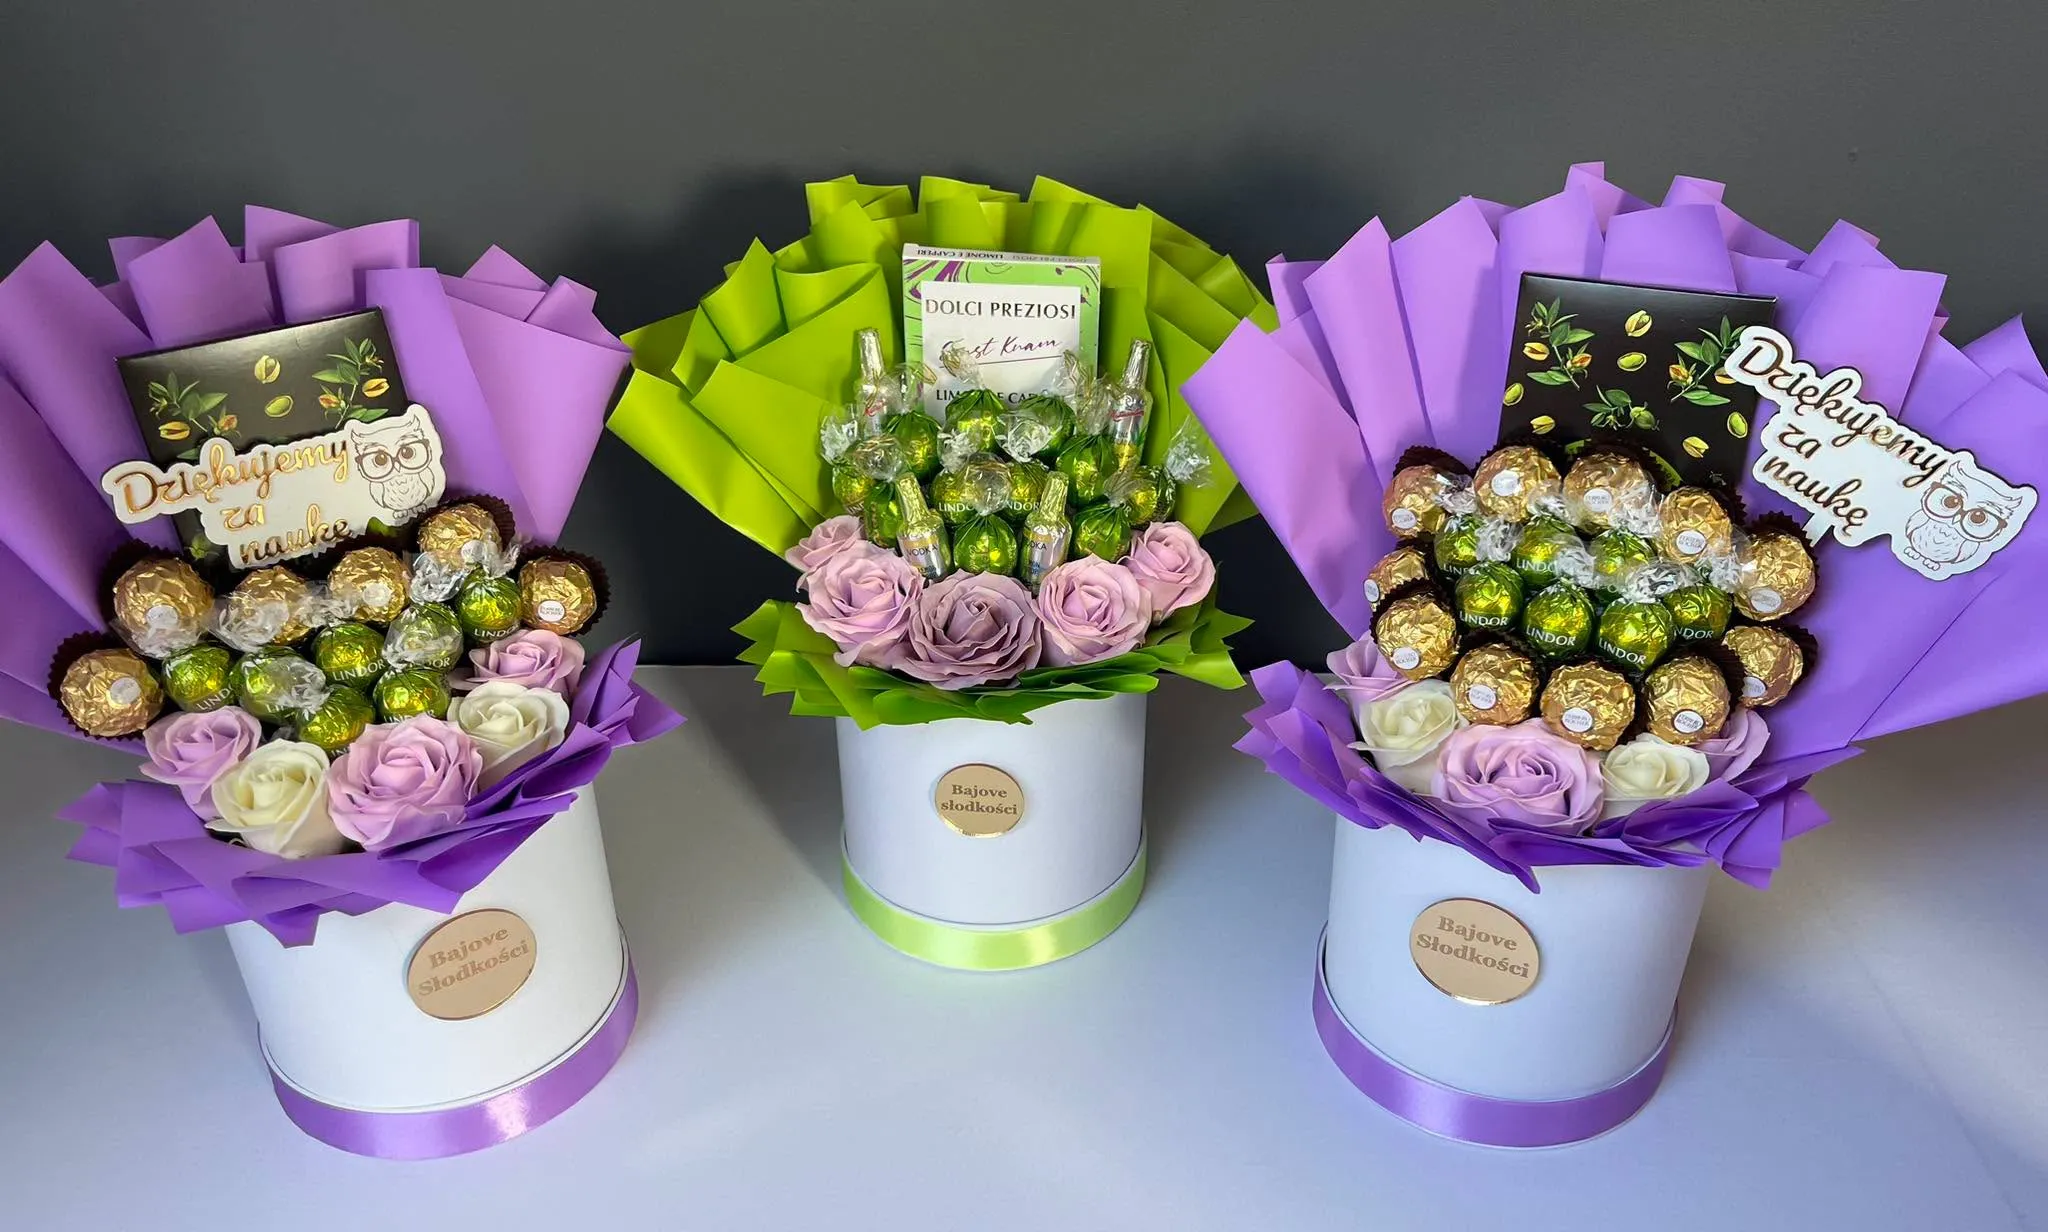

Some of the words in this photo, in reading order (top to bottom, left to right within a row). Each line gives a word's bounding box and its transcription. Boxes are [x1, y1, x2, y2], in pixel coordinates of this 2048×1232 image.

[926, 299, 982, 316] DOLCI
[990, 302, 1076, 319] PREZIOSI
[1738, 336, 1948, 488] Dziękujemy
[1778, 423, 1822, 459] za
[114, 440, 348, 514] Dziękujemy
[1762, 456, 1869, 537] naukę
[220, 503, 266, 531] za
[1459, 611, 1509, 627] LINDOR
[1526, 626, 1576, 647] LINDOR
[1599, 637, 1647, 665] LINDOR
[332, 658, 386, 682] LINDOR
[951, 784, 1008, 798] Bajove
[940, 800, 1018, 815] słodkości
[1438, 915, 1518, 951] Bajove
[428, 928, 509, 969] Bajove
[1416, 933, 1530, 979] Słodkości
